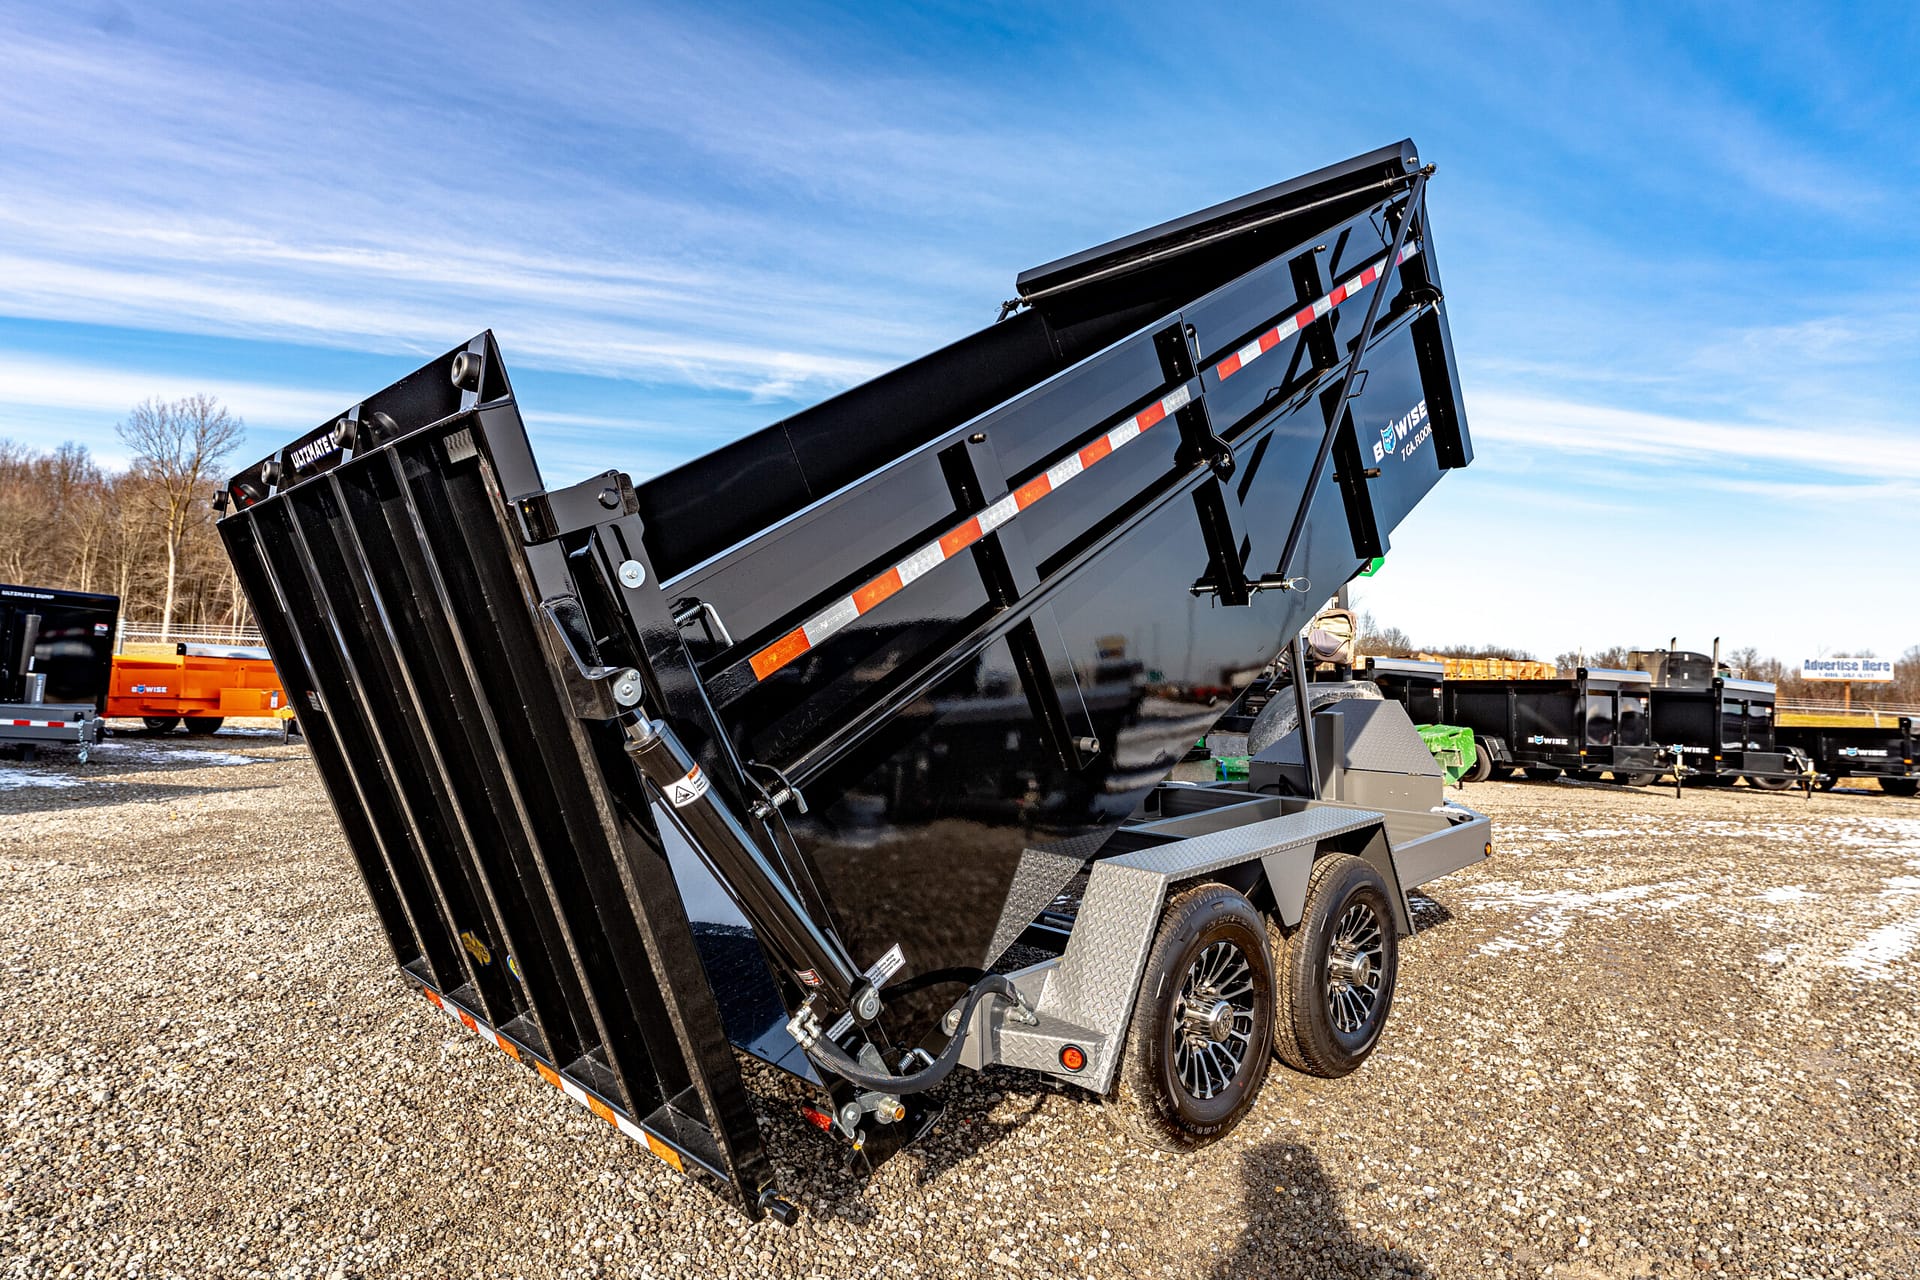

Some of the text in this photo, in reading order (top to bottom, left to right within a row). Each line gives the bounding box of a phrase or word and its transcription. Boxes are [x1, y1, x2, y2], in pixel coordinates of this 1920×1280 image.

[290, 434, 332, 470] ULTIMATE
[1804, 659, 1891, 672] Advertise Here
